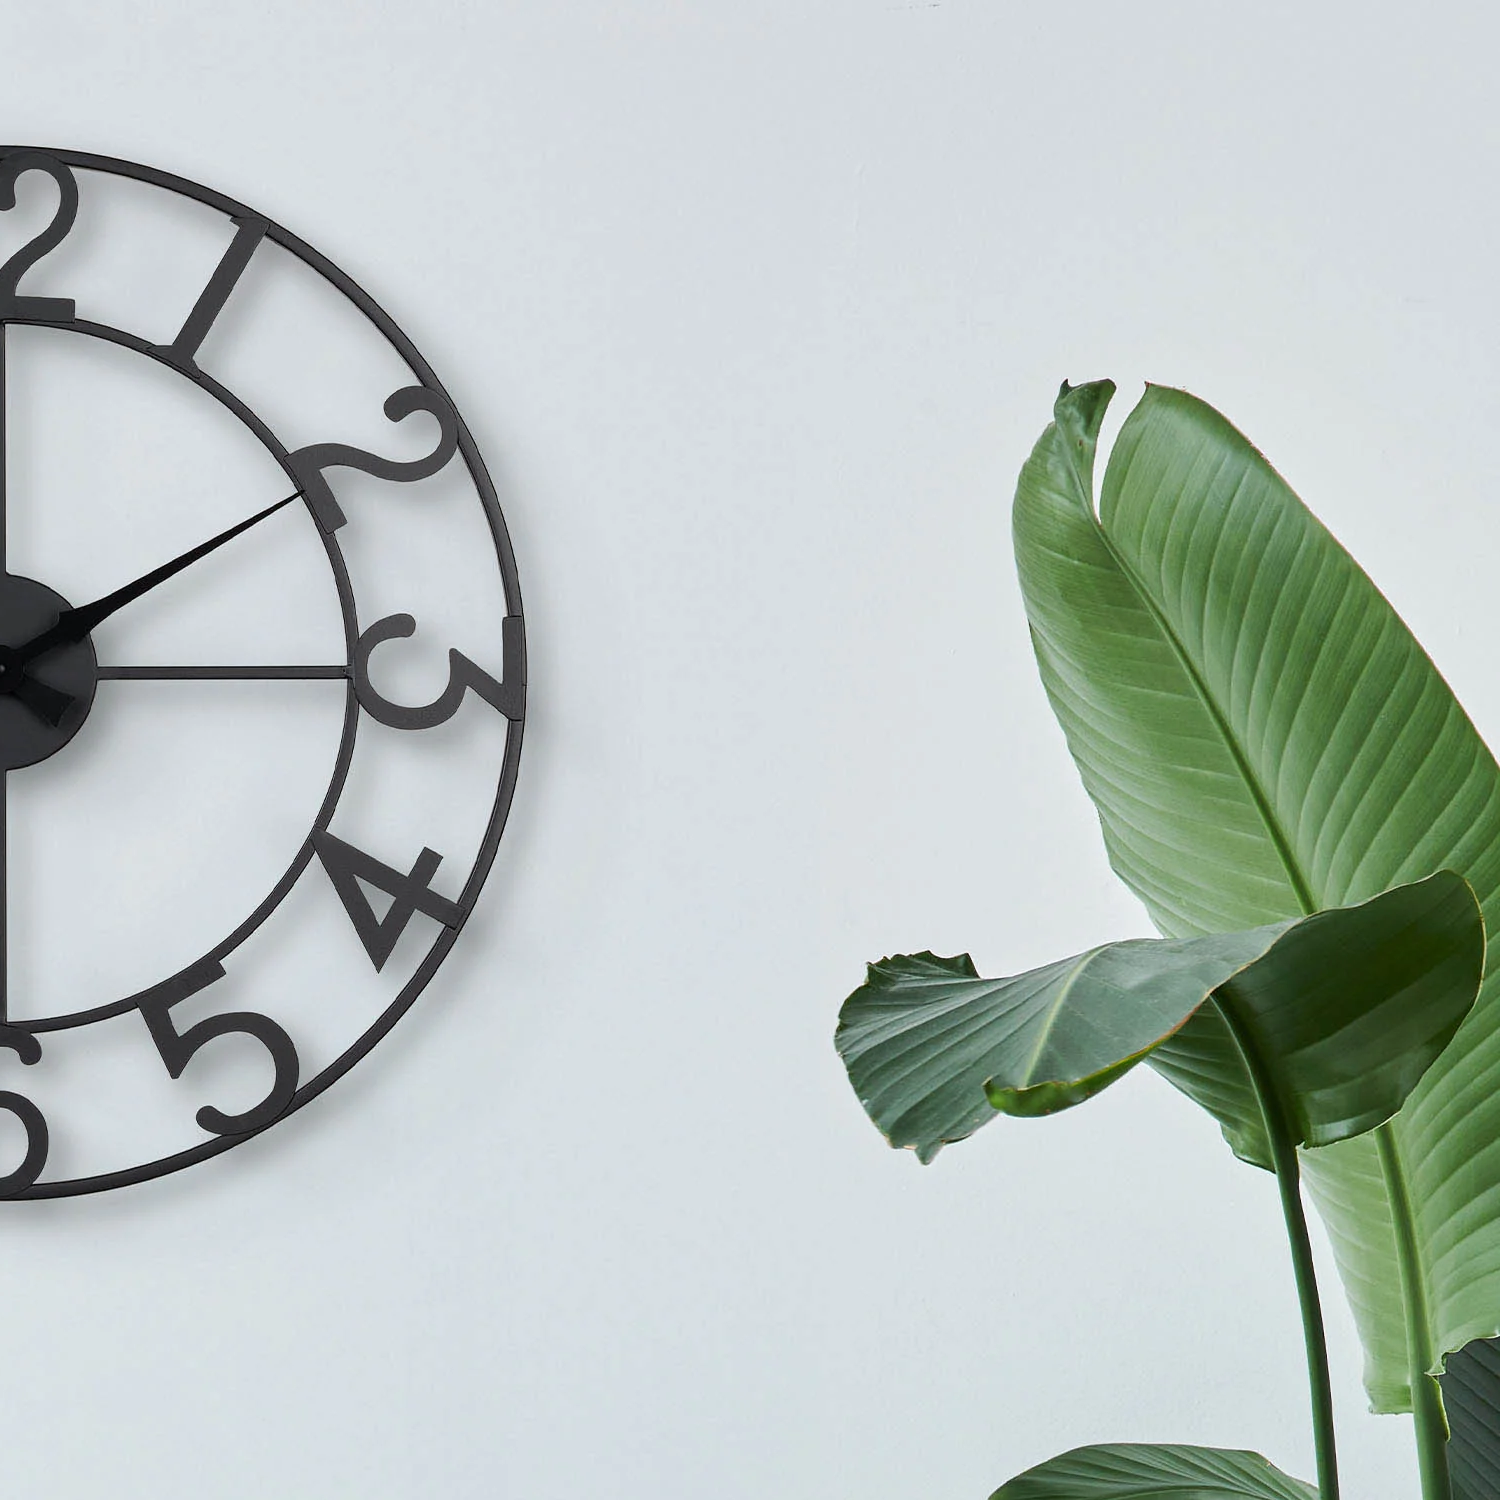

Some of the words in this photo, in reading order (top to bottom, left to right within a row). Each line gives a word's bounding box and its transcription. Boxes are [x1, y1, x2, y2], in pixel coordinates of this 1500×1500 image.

[147, 216, 270, 378] 1
[284, 385, 459, 534] 2
[353, 613, 523, 730] 3
[311, 826, 466, 973] 4
[136, 959, 299, 1135] 5
